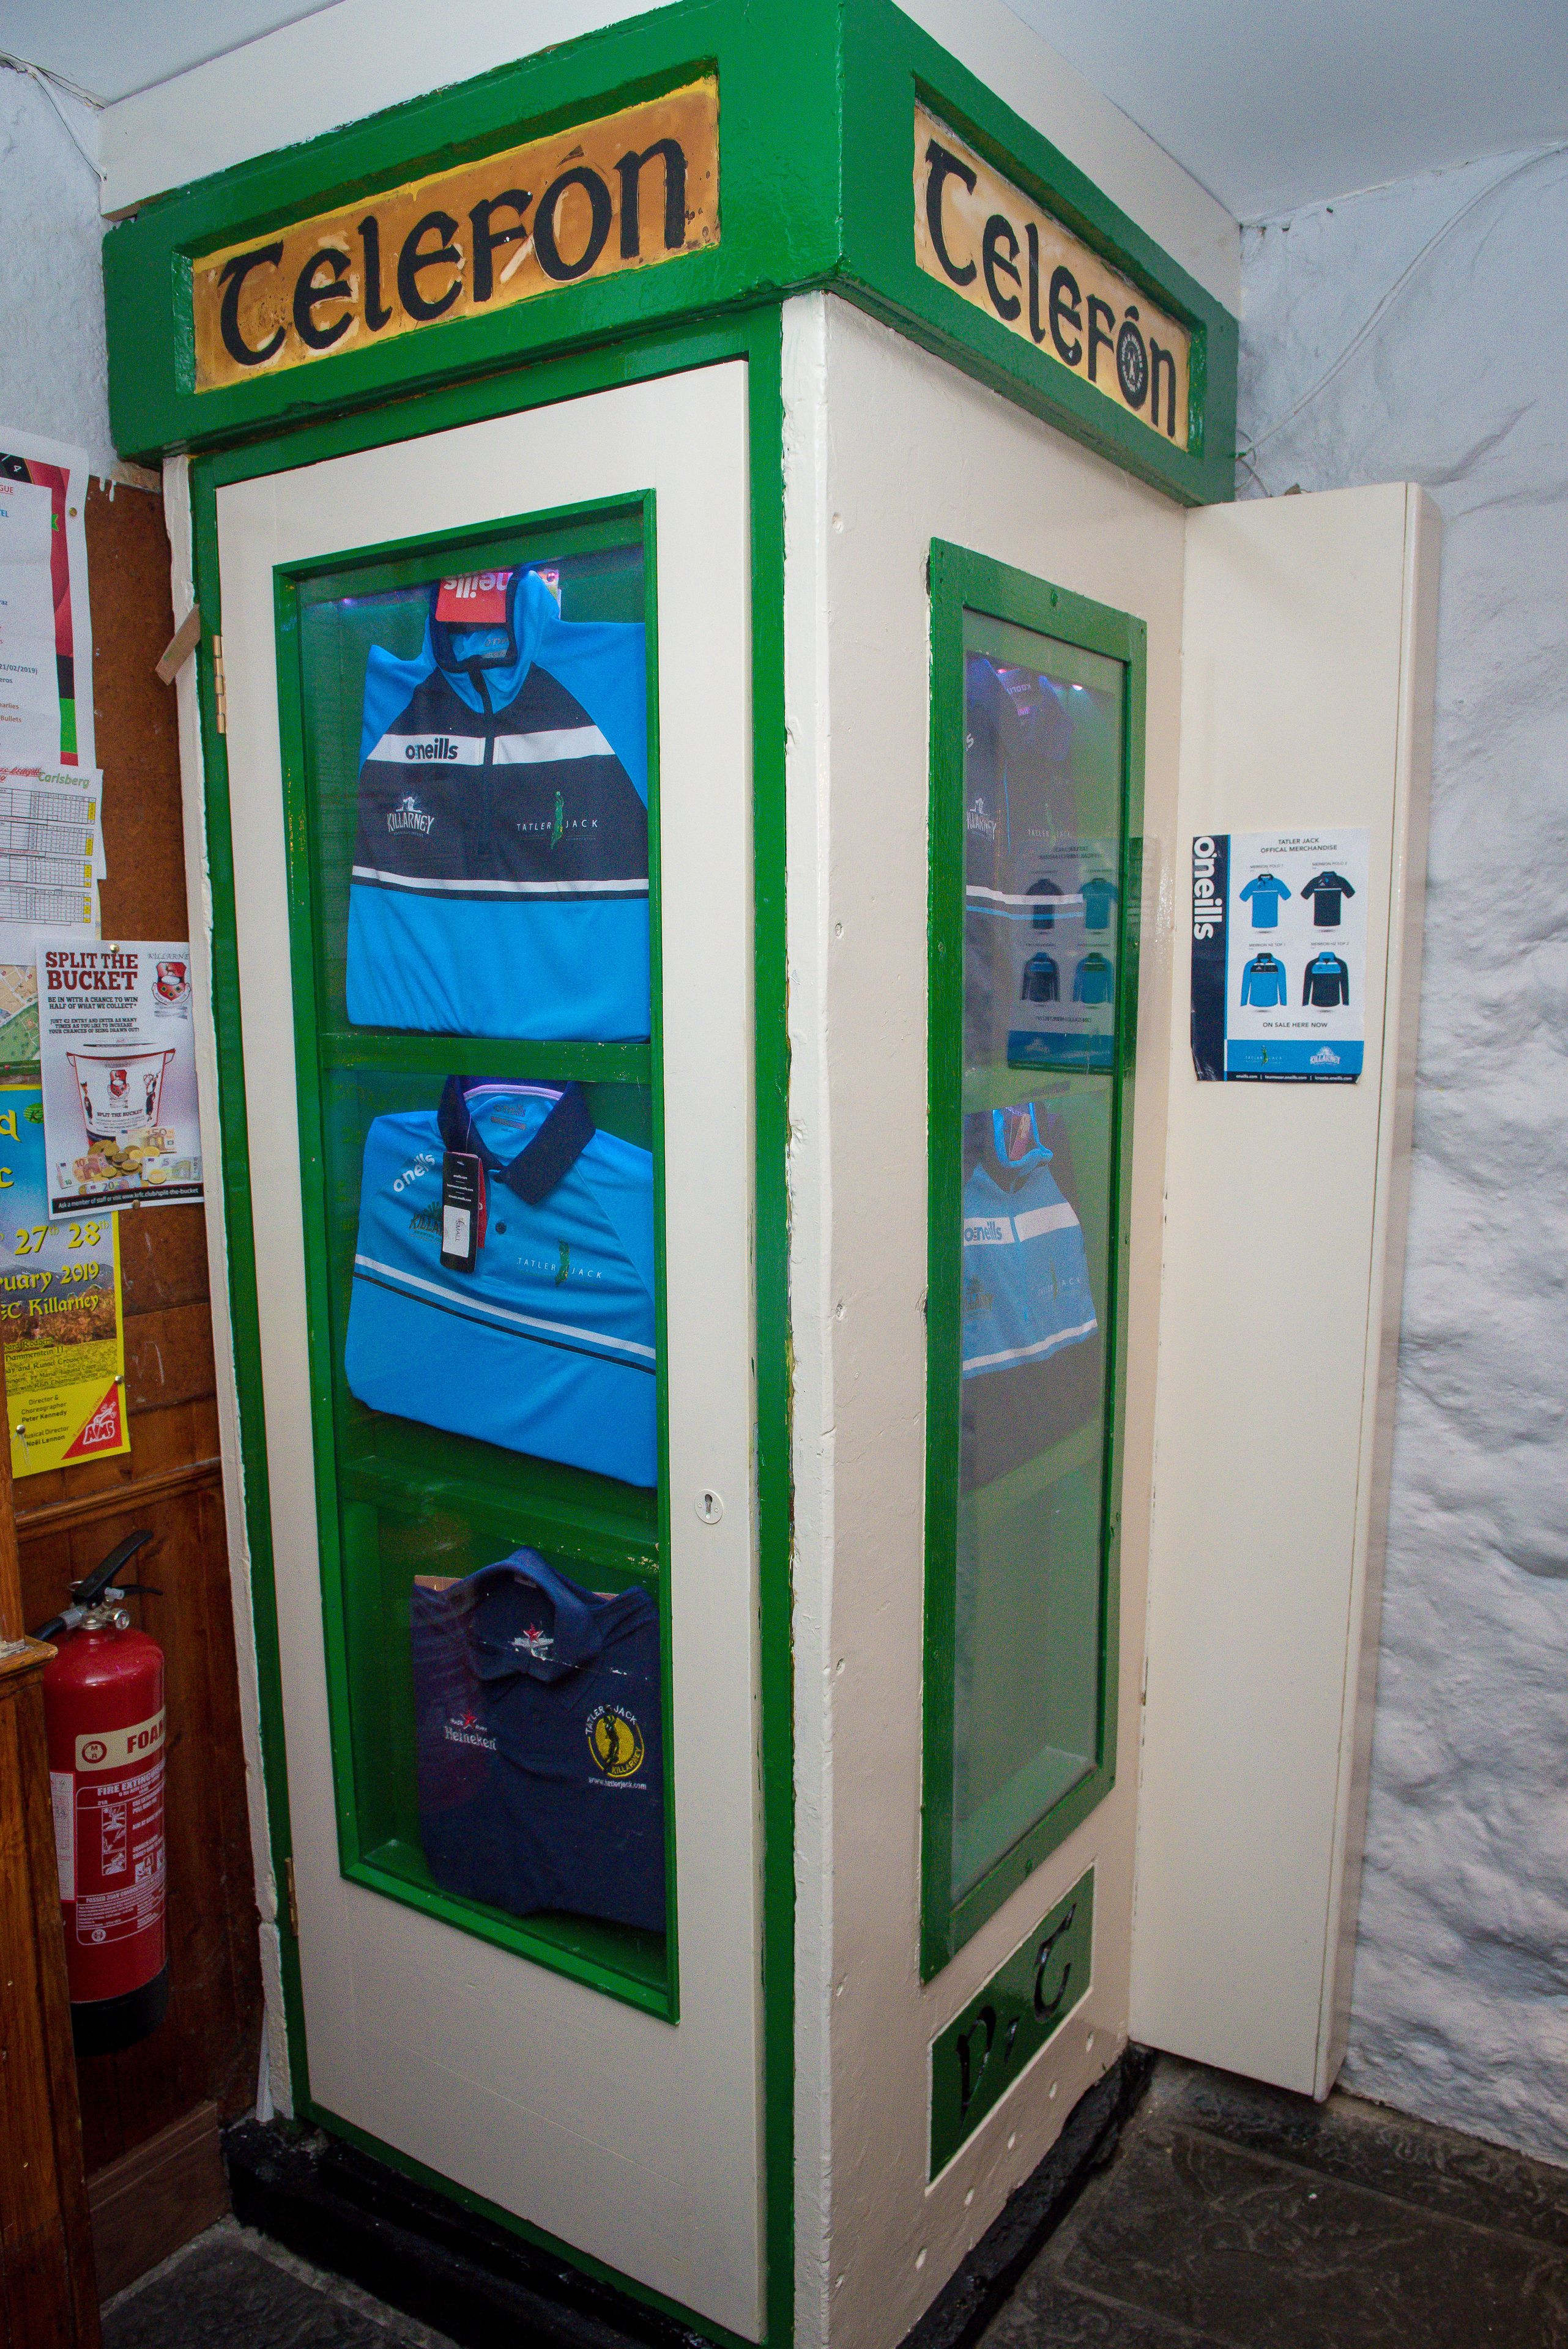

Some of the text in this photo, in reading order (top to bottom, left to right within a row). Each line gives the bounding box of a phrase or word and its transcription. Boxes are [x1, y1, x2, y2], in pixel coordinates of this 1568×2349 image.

[38, 772, 91, 789] Carlsberg
[387, 812, 435, 834] KILLARNEY
[516, 820, 598, 831] TATLER JACK
[45, 951, 138, 969] SPLIT THE
[46, 970, 138, 990] BUCKET
[72, 1199, 90, 1208] member
[60, 1261, 100, 1285] 2019
[518, 1257, 603, 1278] TATLER JACK
[29, 1294, 99, 1316] Killarney
[21, 1402, 67, 1415] Choreographer
[28, 1397, 53, 1406] Director
[21, 1410, 67, 1423] Peter Kennedy
[45, 1425, 69, 1435] Director
[42, 1434, 65, 1444] Lennon
[585, 1705, 637, 1735] TATLER JACK
[612, 1746, 641, 1774] KILLARNEY
[97, 1783, 120, 1797] FIRE
